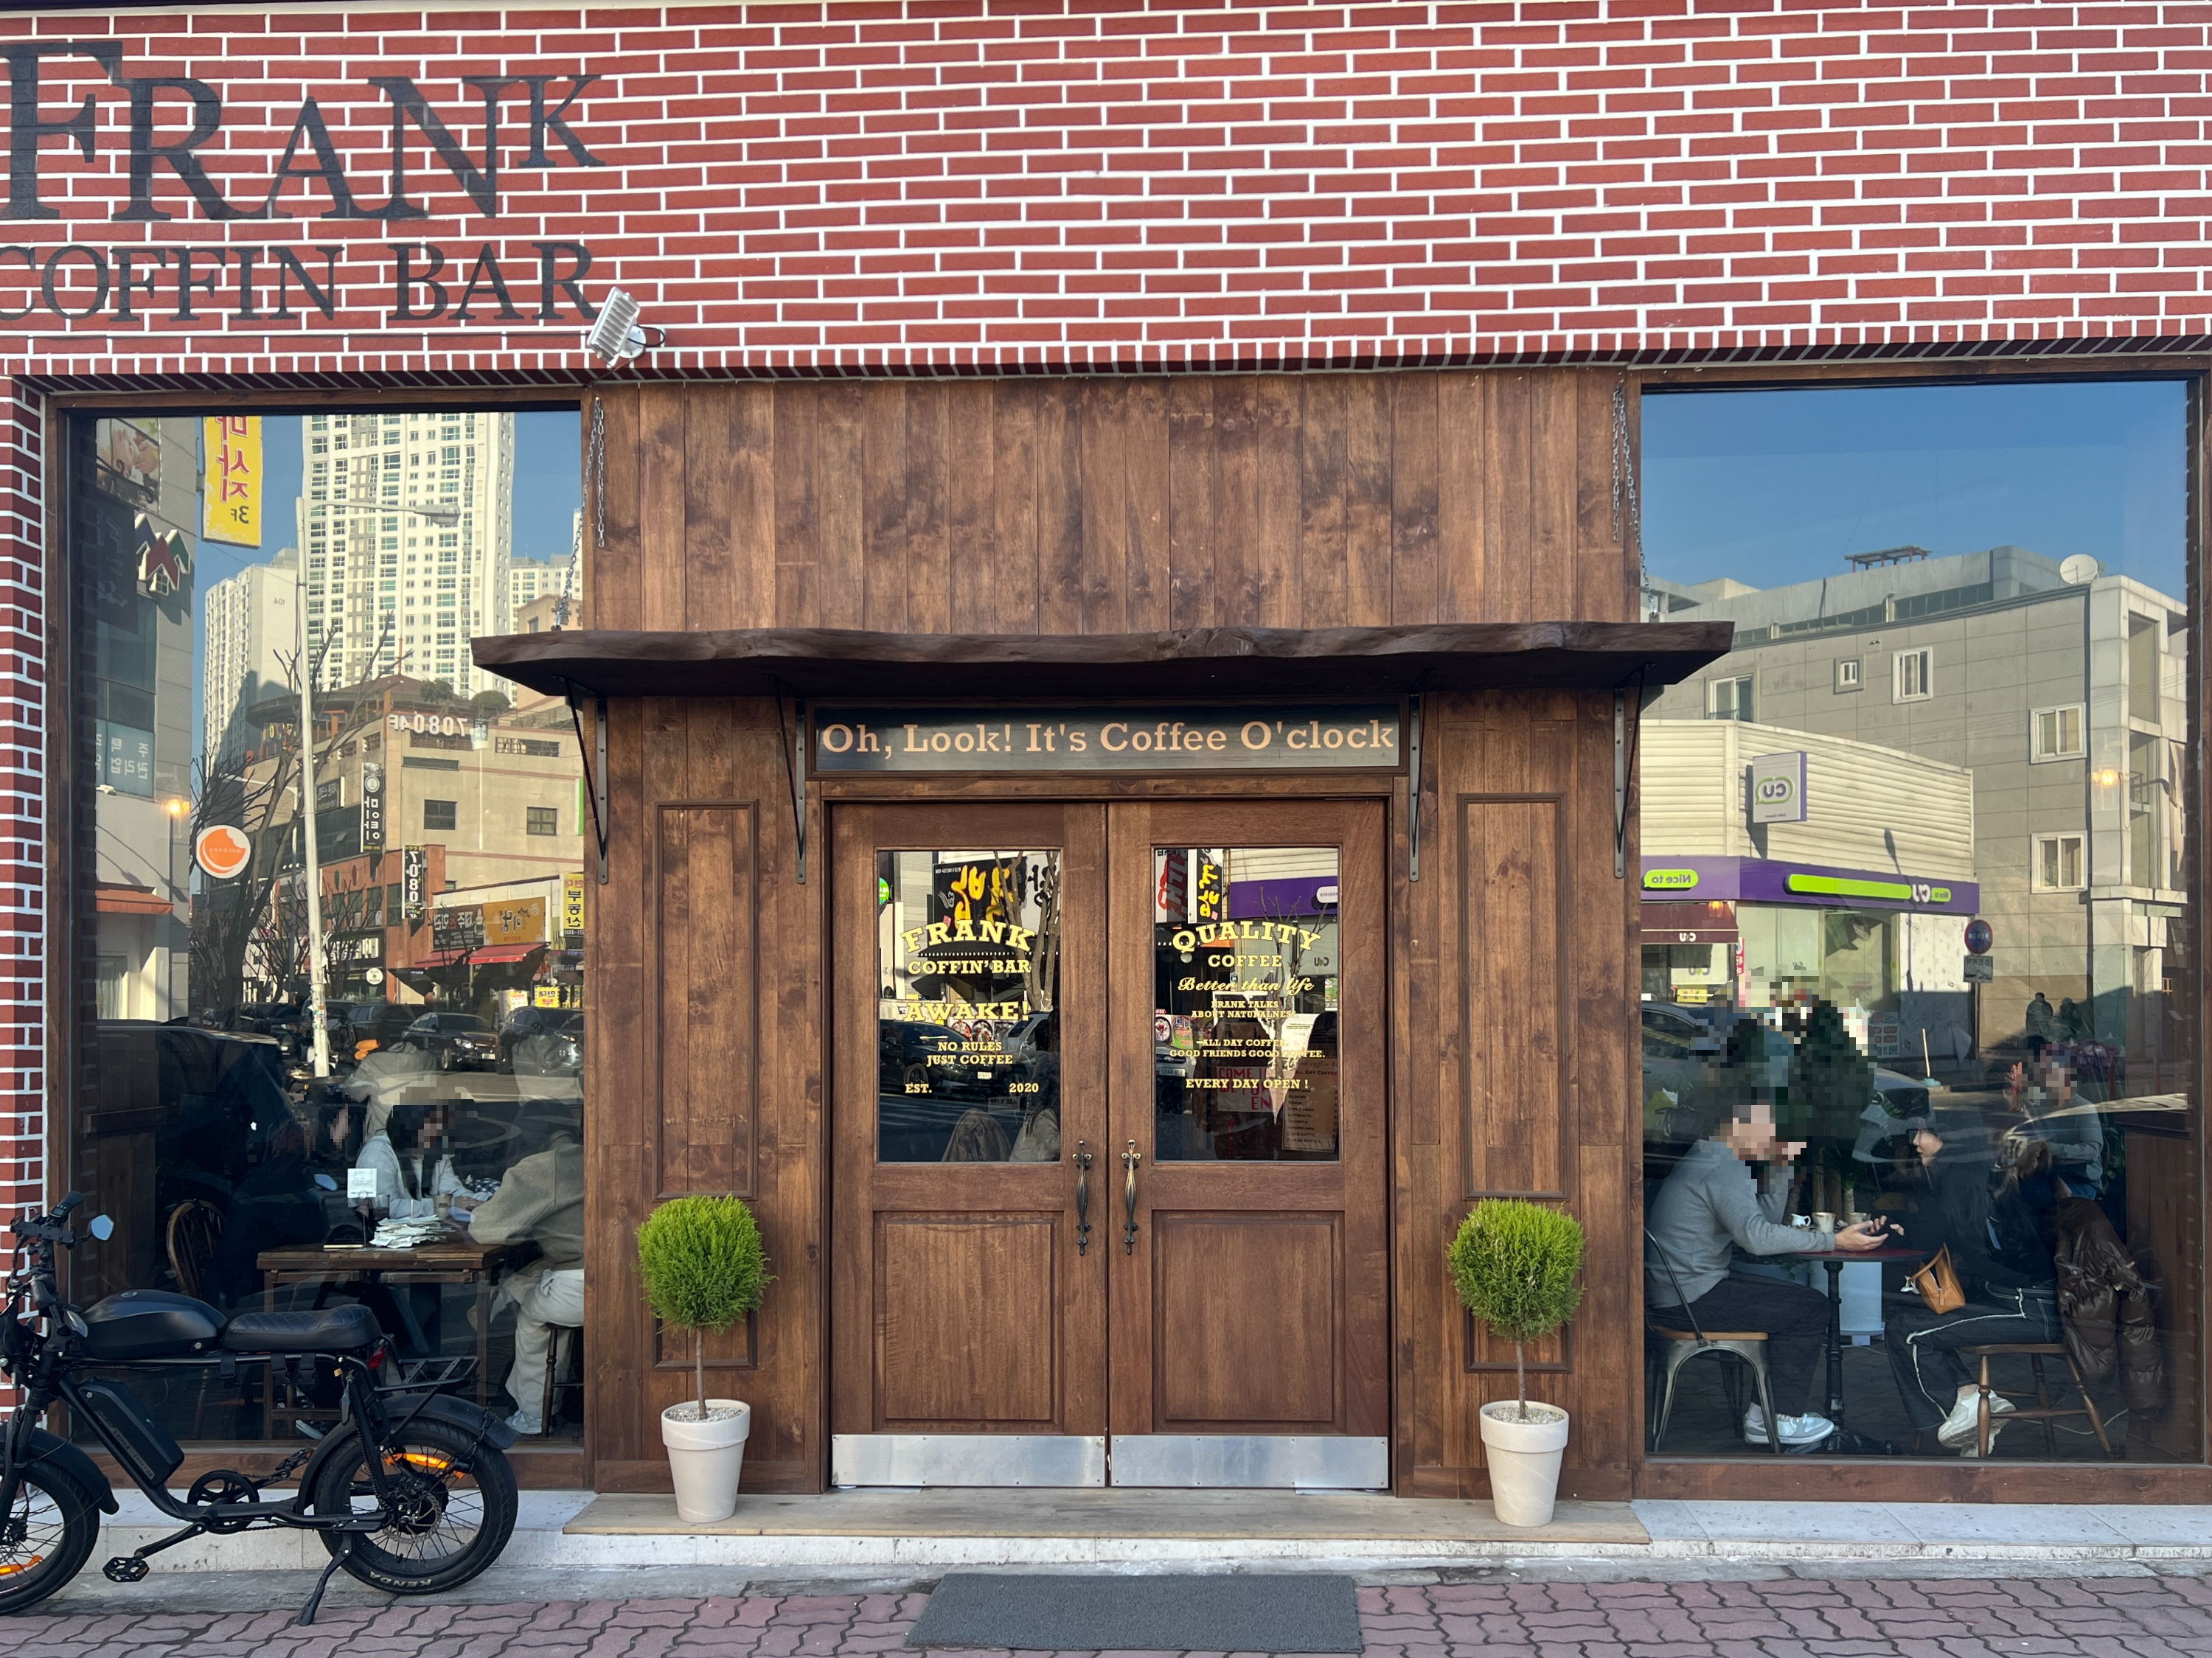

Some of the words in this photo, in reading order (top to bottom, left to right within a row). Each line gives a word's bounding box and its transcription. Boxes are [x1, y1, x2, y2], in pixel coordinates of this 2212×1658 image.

[0, 41, 605, 222] FRANK
[0, 244, 344, 322] COFFIN
[386, 242, 599, 321] BAR
[822, 724, 892, 759] Oh,
[902, 722, 1011, 753] Look!
[1025, 723, 1088, 752] It's
[1099, 721, 1228, 751] Coffee
[1240, 720, 1394, 750] O'clock
[900, 919, 1035, 952] FRANK
[1172, 921, 1321, 953] QUALITY
[908, 961, 989, 975] COFFIN'
[992, 960, 1032, 974] BAR
[1208, 955, 1282, 967] COFFEE
[1178, 977, 1237, 992] Better
[1241, 978, 1281, 992] than
[1286, 977, 1315, 995] life
[905, 1001, 1029, 1021] AWAKE!
[1211, 1000, 1246, 1009] FRANK
[1248, 1000, 1279, 1009] TALKS
[1192, 1010, 1225, 1018] ABOUT
[938, 1042, 958, 1051] NO
[961, 1041, 1002, 1051] RULES
[1169, 1050, 1201, 1058] GOOD
[1203, 1050, 1247, 1058] FRIENDS
[1248, 1050, 1280, 1058] GOOD
[927, 1055, 956, 1067] JUST
[959, 1055, 1013, 1065] COFFEE
[1219, 1067, 1253, 1079] COME
[905, 1084, 933, 1093] EST.
[1009, 1083, 1040, 1093] 2020
[1186, 1079, 1229, 1089] EVERY
[1232, 1079, 1259, 1089] DAY
[1263, 1079, 1301, 1089] OPEN
[369, 1570, 432, 1588] KENDA
